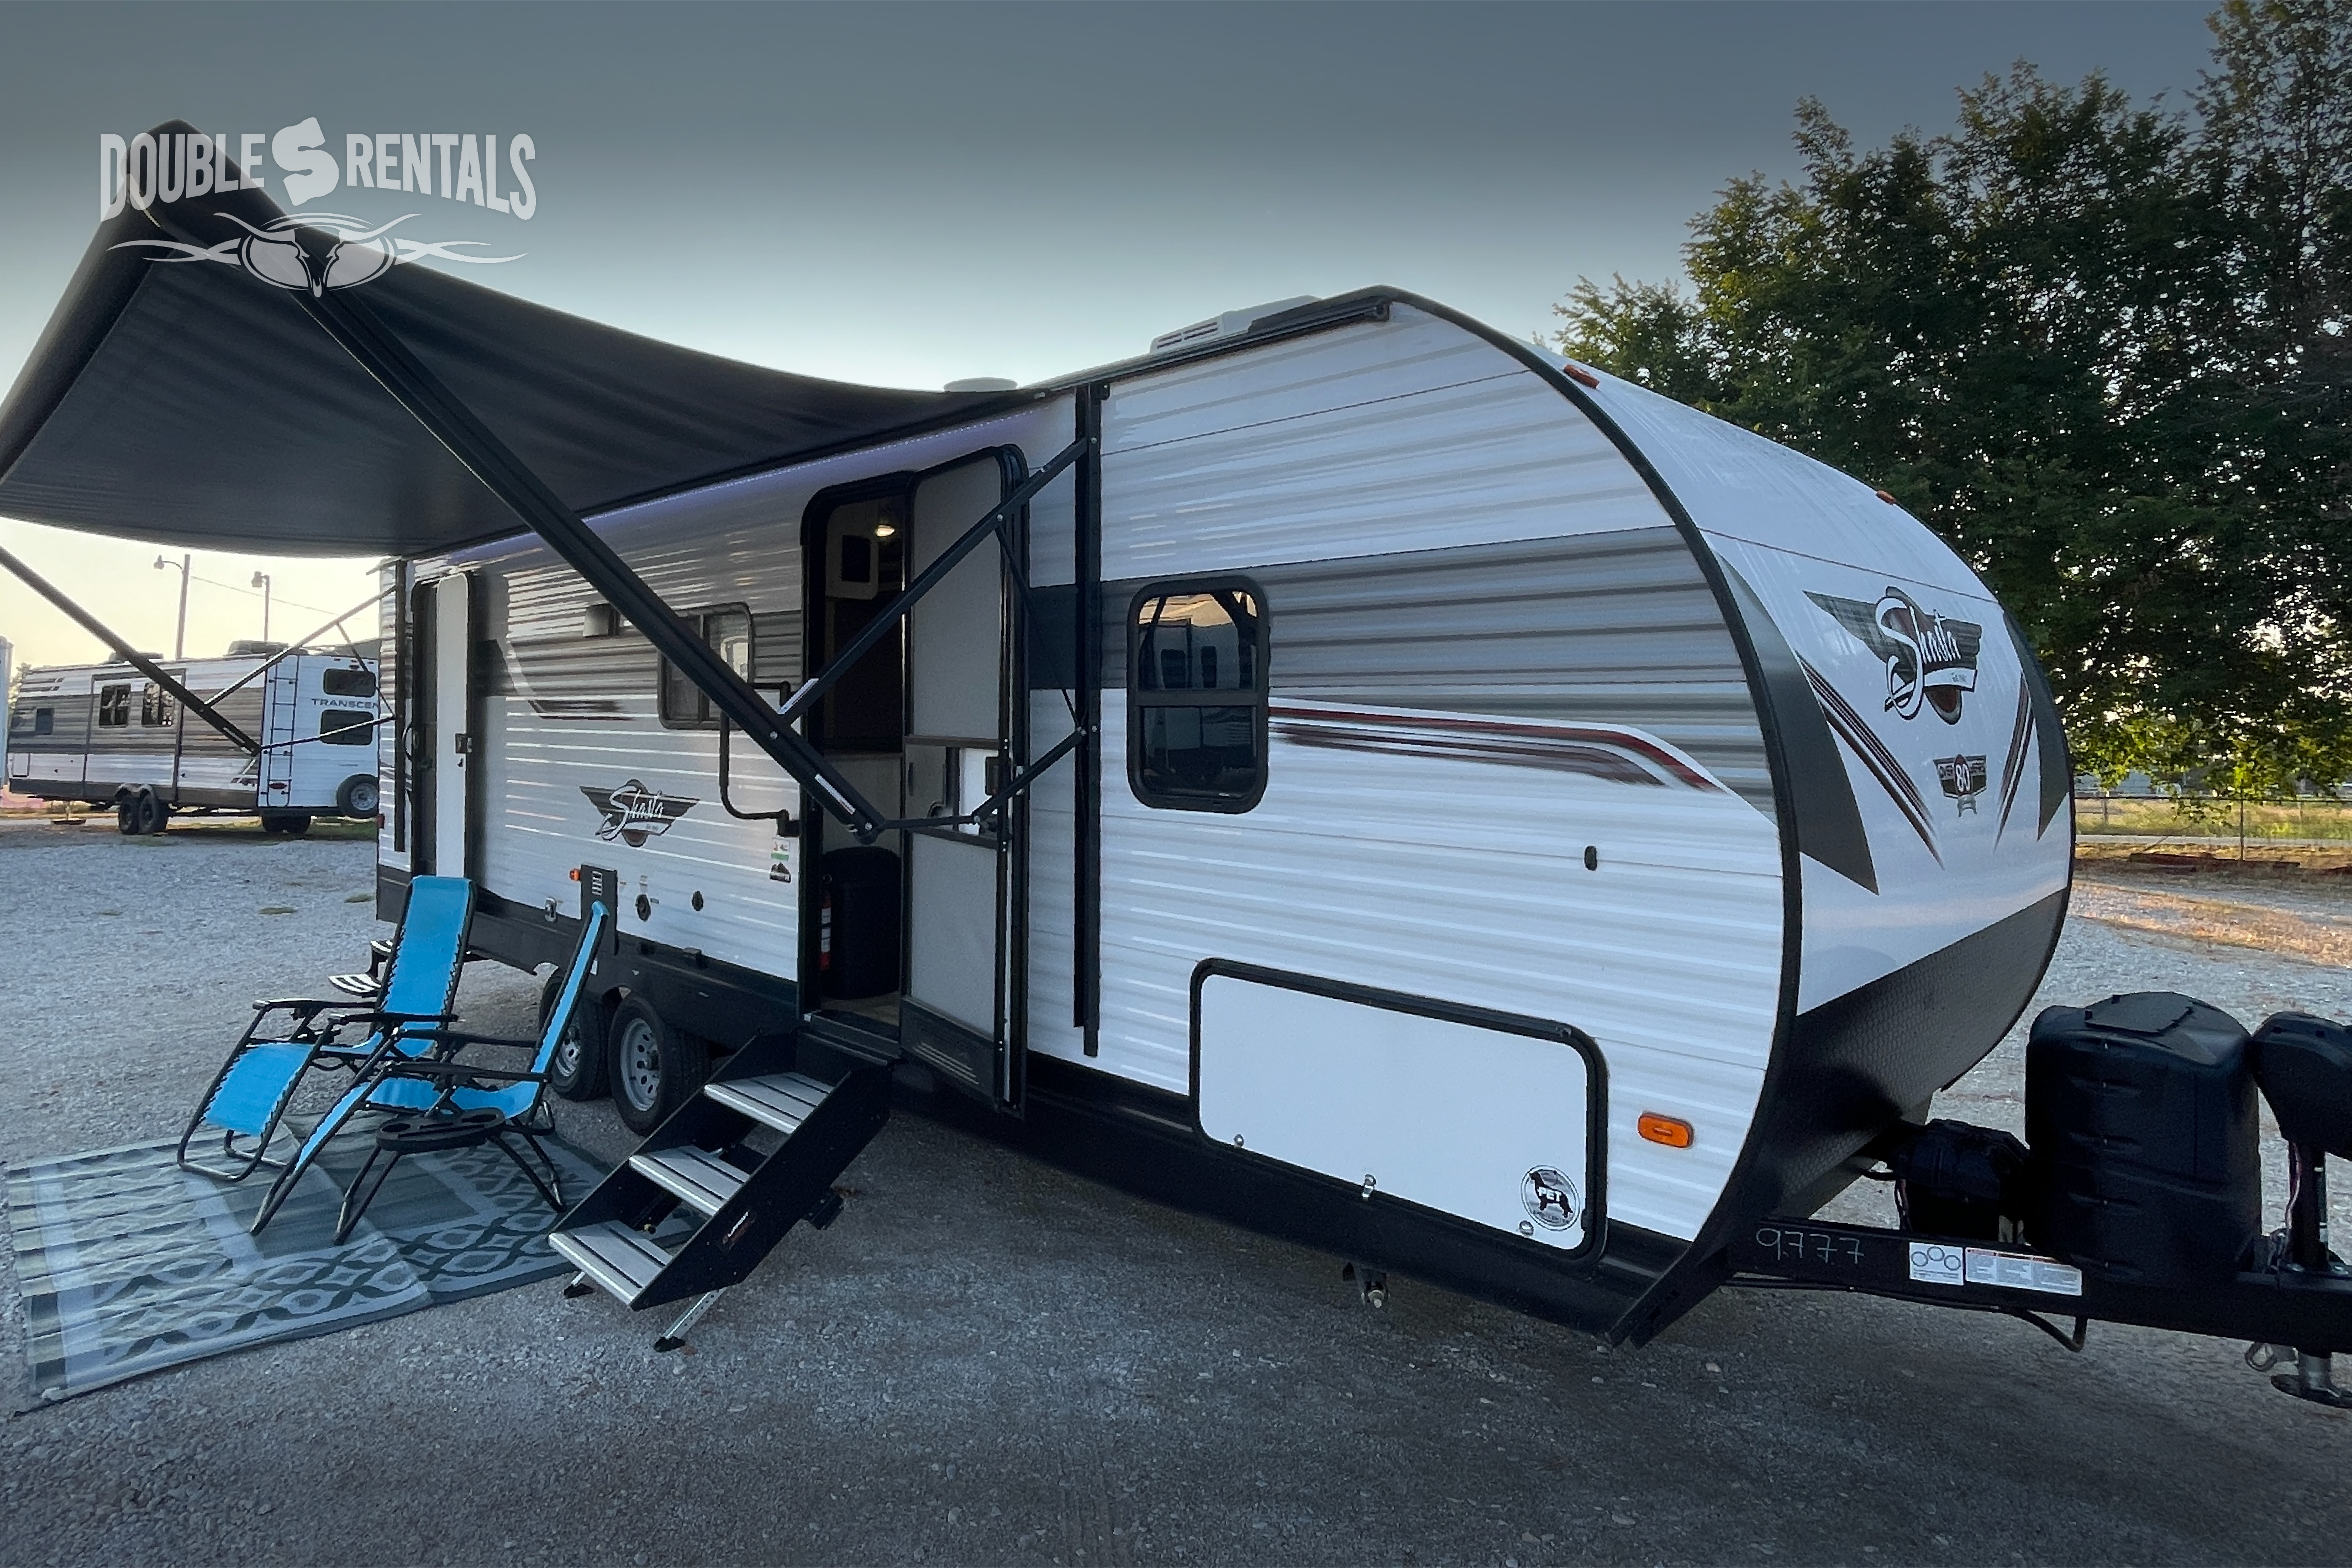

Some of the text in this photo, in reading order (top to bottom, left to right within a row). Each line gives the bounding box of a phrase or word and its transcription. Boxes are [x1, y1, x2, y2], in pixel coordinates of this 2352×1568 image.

[595, 786, 664, 841] Shasta
[1537, 1186, 1562, 1202] PET
[1756, 1228, 1865, 1264] 9777
